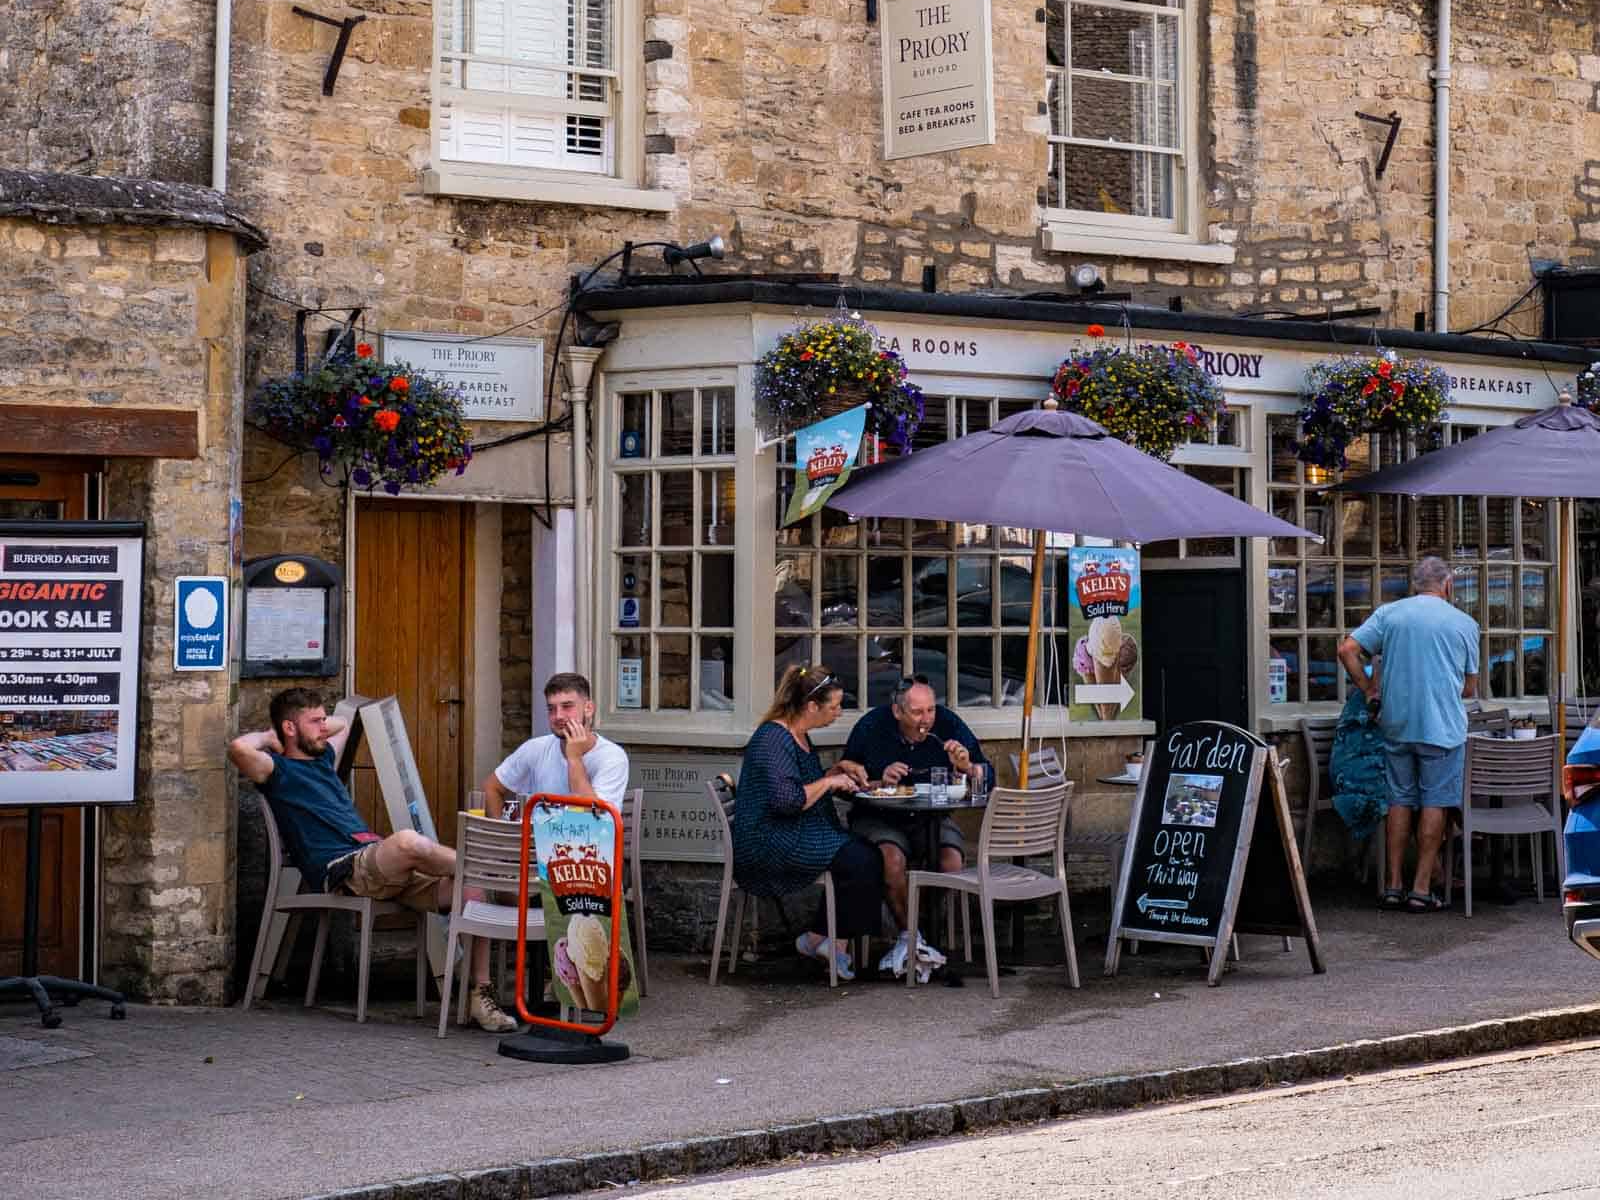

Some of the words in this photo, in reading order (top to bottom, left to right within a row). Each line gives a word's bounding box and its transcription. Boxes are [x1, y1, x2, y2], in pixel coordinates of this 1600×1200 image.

[916, 4, 952, 27] THE
[899, 31, 970, 62] PRIORY
[913, 63, 958, 78] BURFORD
[900, 108, 922, 121] CAFE
[924, 106, 940, 117] TEA
[943, 100, 975, 112] ROOMS
[898, 124, 915, 135] BED
[918, 122, 924, 132] &
[926, 114, 977, 130] BREAKFAST
[431, 348, 453, 361] THE
[457, 347, 497, 362] PRIORY
[878, 336, 901, 350] EA
[912, 338, 977, 357] ROOMS
[460, 381, 508, 393] GARDEN
[1450, 376, 1533, 395] BREAKFAST
[464, 395, 516, 407] EAKFAST
[13, 554, 63, 564] BURFORD
[64, 554, 110, 564] ARCHIVE
[0, 582, 108, 600] GIGANTIC
[1081, 575, 1127, 595] KELLY'S
[1087, 602, 1105, 617] Sold
[1106, 601, 1125, 613] Here
[0, 610, 48, 628] OOK
[54, 610, 113, 628] SALE
[10, 649, 33, 658] 29th
[42, 649, 61, 658] Sat
[63, 648, 85, 658] 31st
[87, 649, 116, 658] JULY
[0, 674, 44, 684] 0.30am
[53, 674, 98, 686] 4.30pm
[0, 695, 26, 704] WICK
[29, 695, 58, 704] HALL,
[63, 694, 111, 703] BURFORD
[1168, 729, 1246, 774] Garden
[664, 767, 699, 781] PRIORY
[653, 809, 675, 820] TEA
[680, 810, 723, 822] ROOM
[656, 827, 724, 840] BREAKFAST
[552, 863, 607, 885] KELLY'S
[1146, 863, 1175, 884] This
[566, 897, 582, 911] Sold
[584, 896, 604, 912] Here
